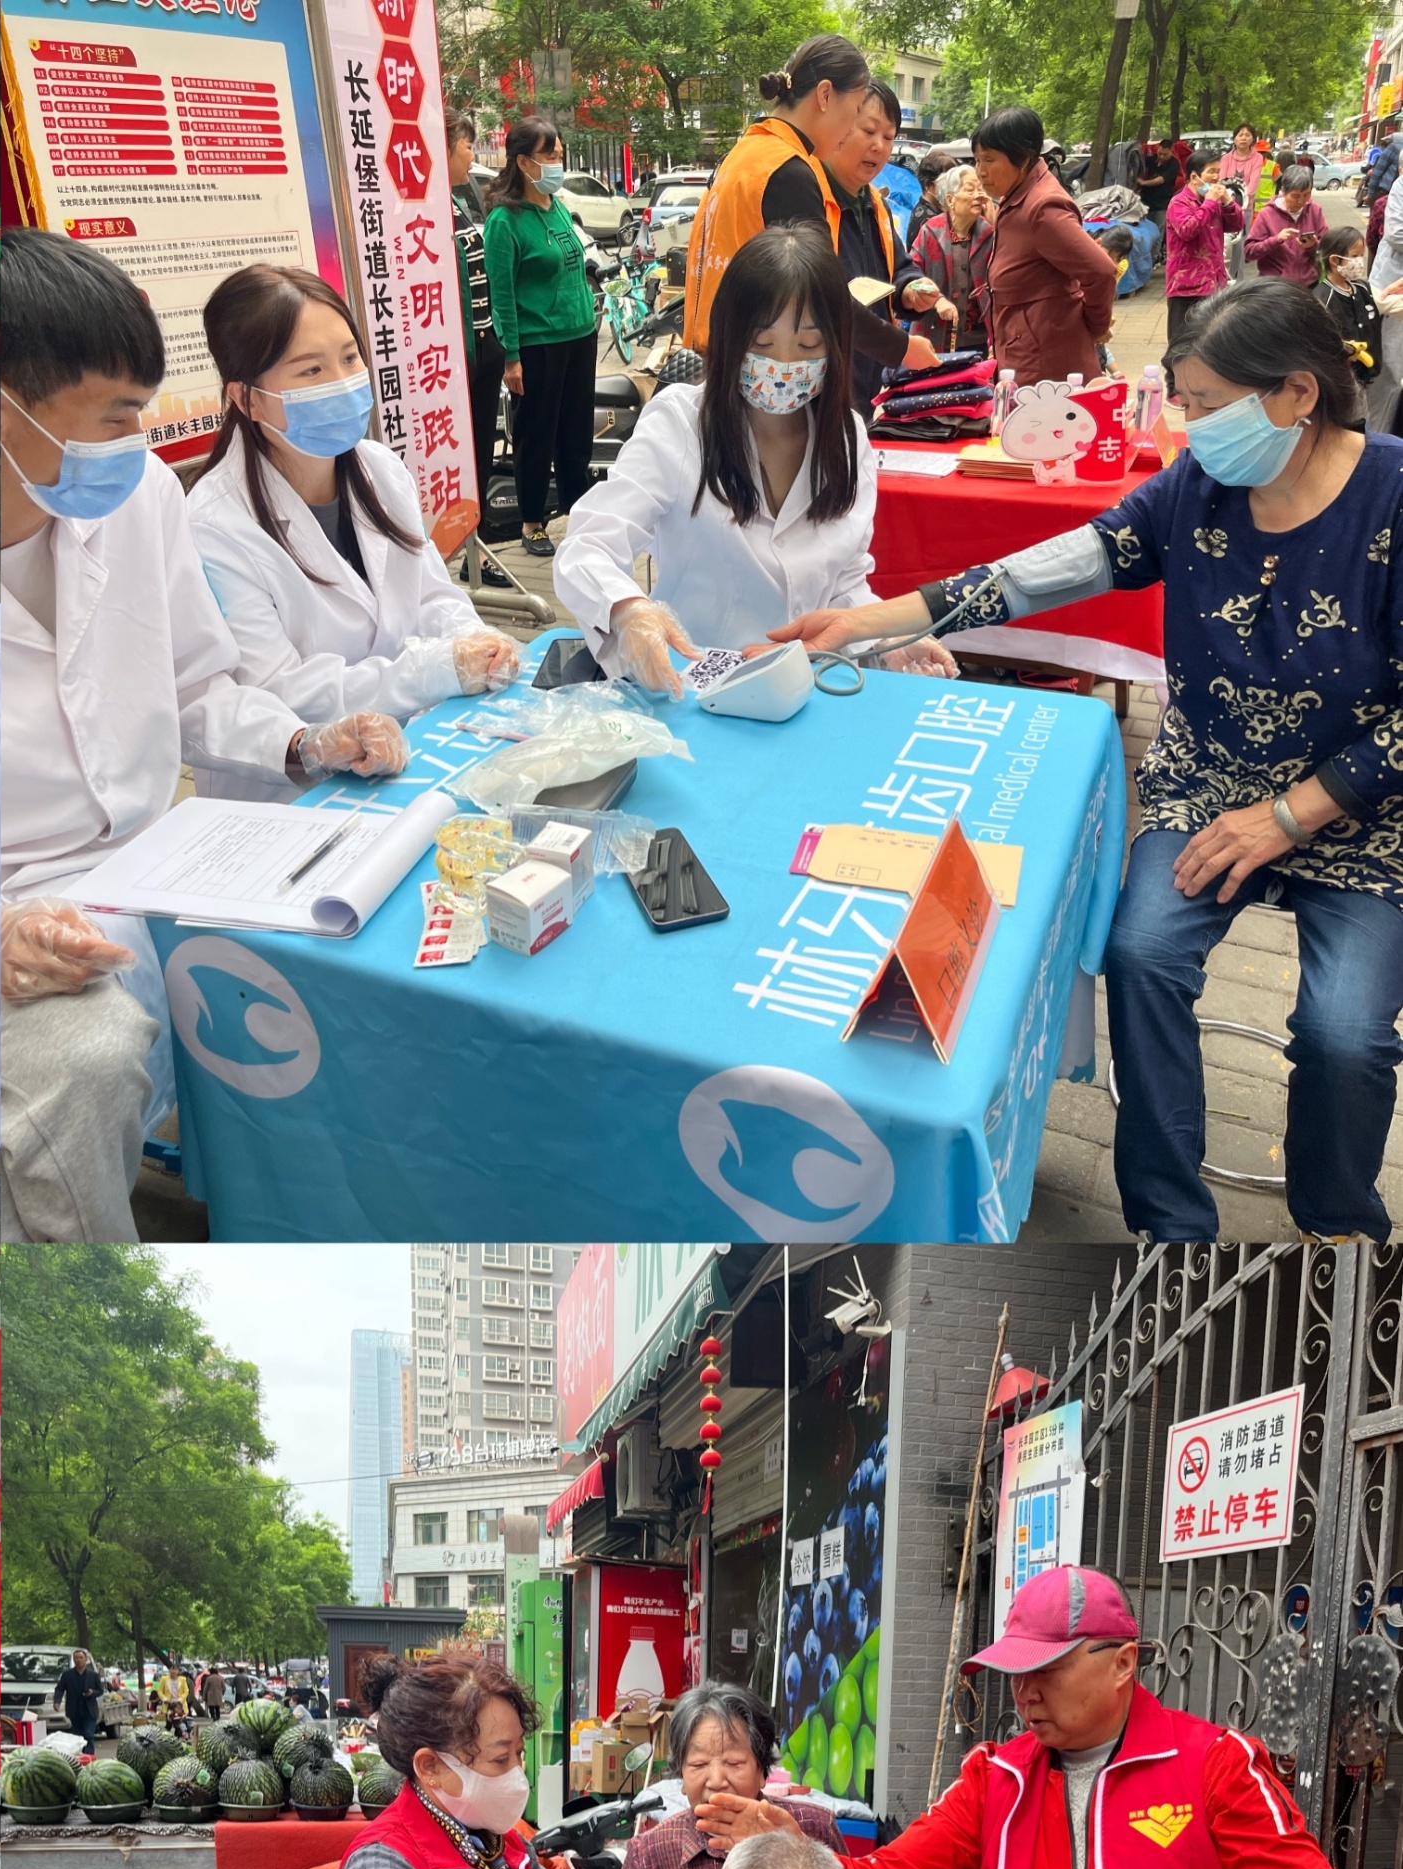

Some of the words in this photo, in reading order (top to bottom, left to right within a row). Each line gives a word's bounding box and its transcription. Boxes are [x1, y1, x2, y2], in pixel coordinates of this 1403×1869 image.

[53, 87, 108, 97] 坚持以人民为中心
[78, 220, 129, 237] 现实意义
[393, 236, 405, 280] WEN
[399, 296, 412, 348] MING
[406, 362, 417, 394] SHI
[411, 407, 423, 451] JIAN
[1112, 403, 1130, 430] 中
[1097, 436, 1122, 463] 志
[416, 464, 429, 514] ZHAN
[986, 750, 1043, 815] medical
[1020, 703, 1061, 748] center
[936, 896, 987, 1013] 口腔义诊
[1219, 1413, 1286, 1453] 消防通道
[1217, 1442, 1284, 1479] 请勿堵占
[1173, 1487, 1280, 1543] 禁止停车
[792, 1555, 813, 1577] 冷饮
[823, 1538, 842, 1570] 雪糕
